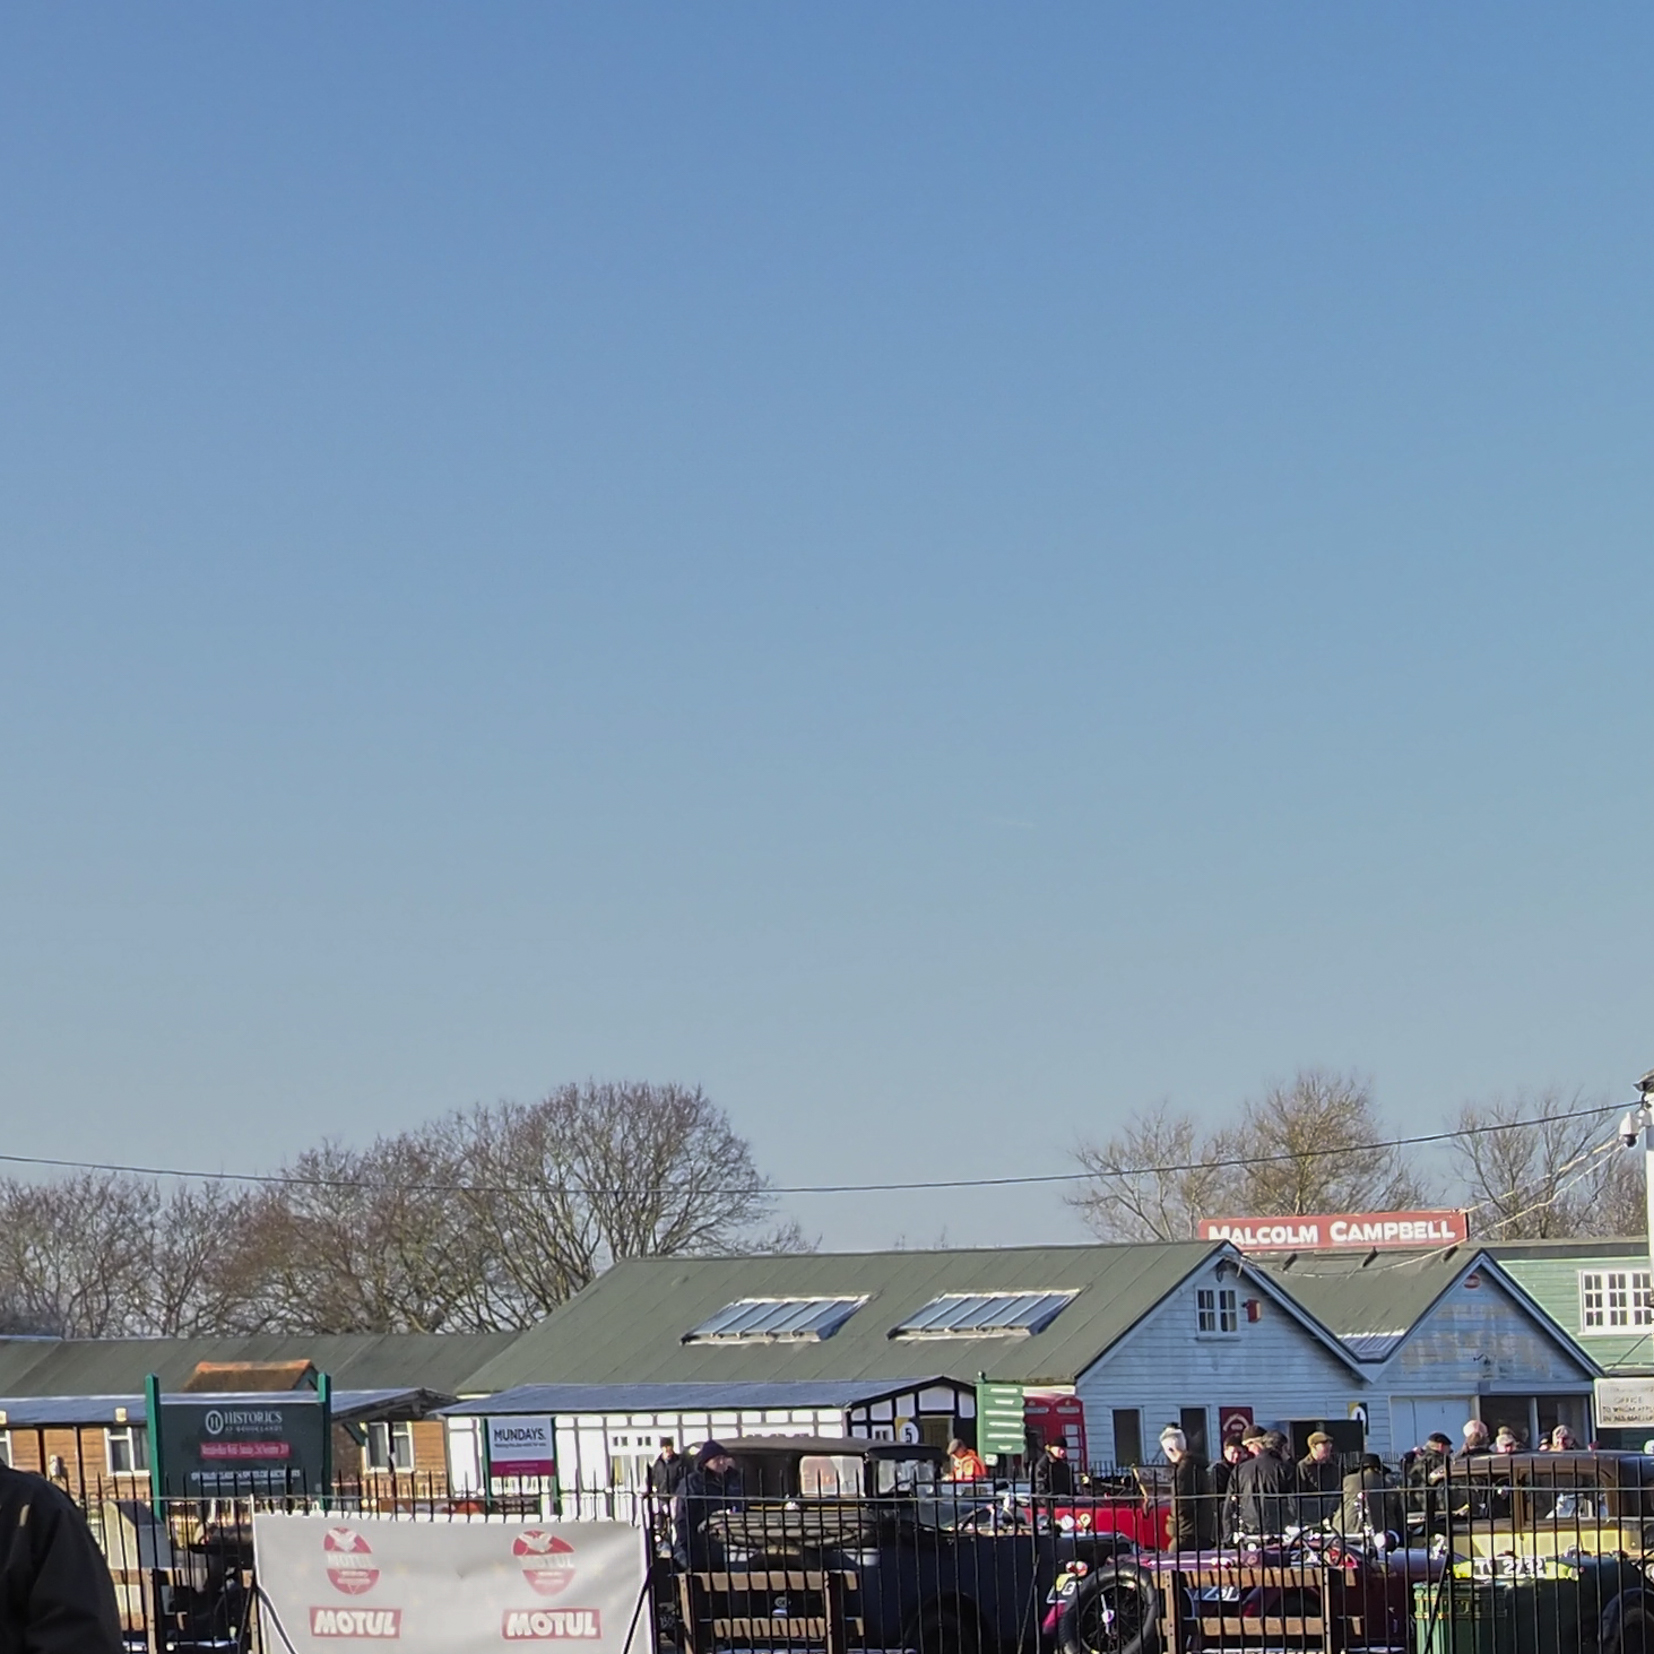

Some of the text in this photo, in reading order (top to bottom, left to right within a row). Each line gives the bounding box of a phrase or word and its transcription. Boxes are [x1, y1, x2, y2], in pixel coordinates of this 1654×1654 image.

[1208, 1220, 1456, 1244] MALCOLM CAMPBELL
[225, 1410, 283, 1424] HISTORICS
[314, 1609, 397, 1636] MOTUL
[506, 1611, 598, 1637] MOTUL
